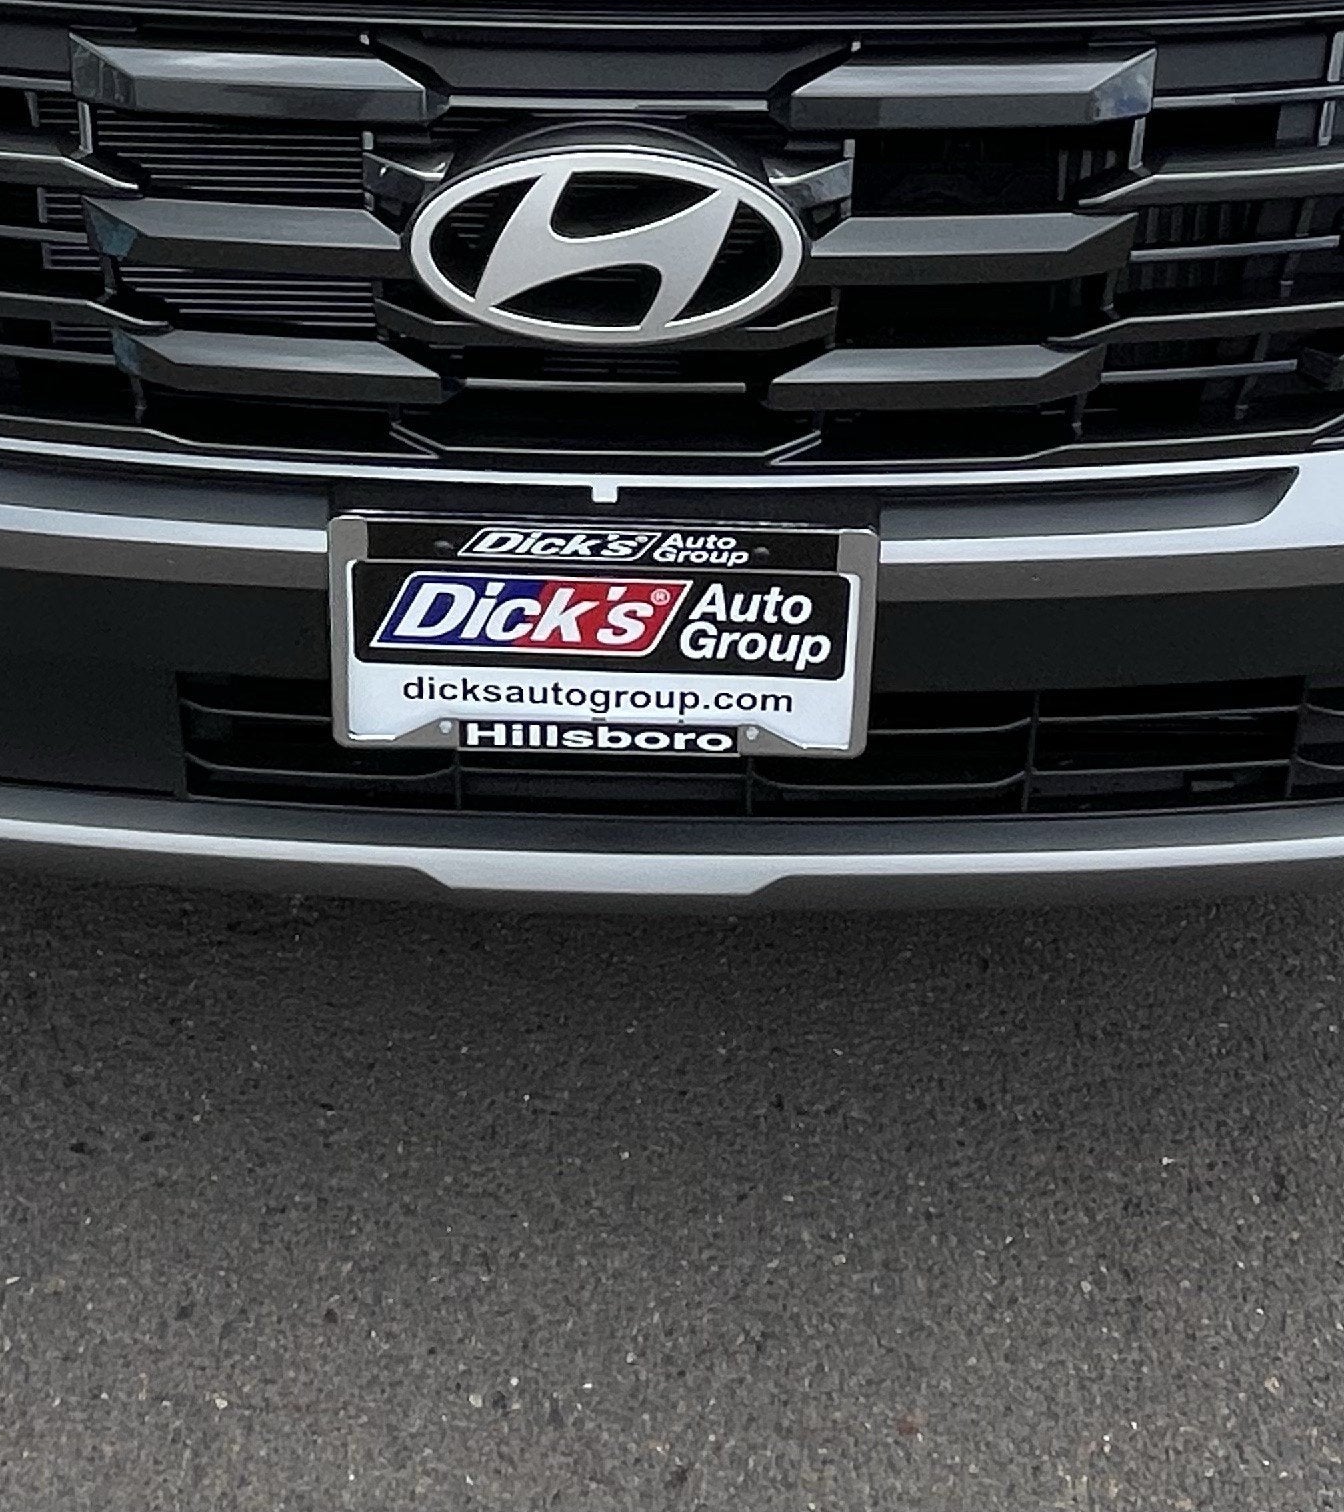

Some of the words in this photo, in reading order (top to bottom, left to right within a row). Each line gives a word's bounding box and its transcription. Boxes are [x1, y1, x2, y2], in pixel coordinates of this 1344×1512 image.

[472, 531, 639, 557] Dick's
[652, 547, 749, 567] Group
[660, 532, 737, 550] Auto
[393, 582, 654, 645] Dick's
[687, 583, 812, 625] Auto
[680, 622, 831, 671] Group
[402, 677, 794, 716] dicksautogroup.com
[465, 722, 734, 752] Hillsboro
